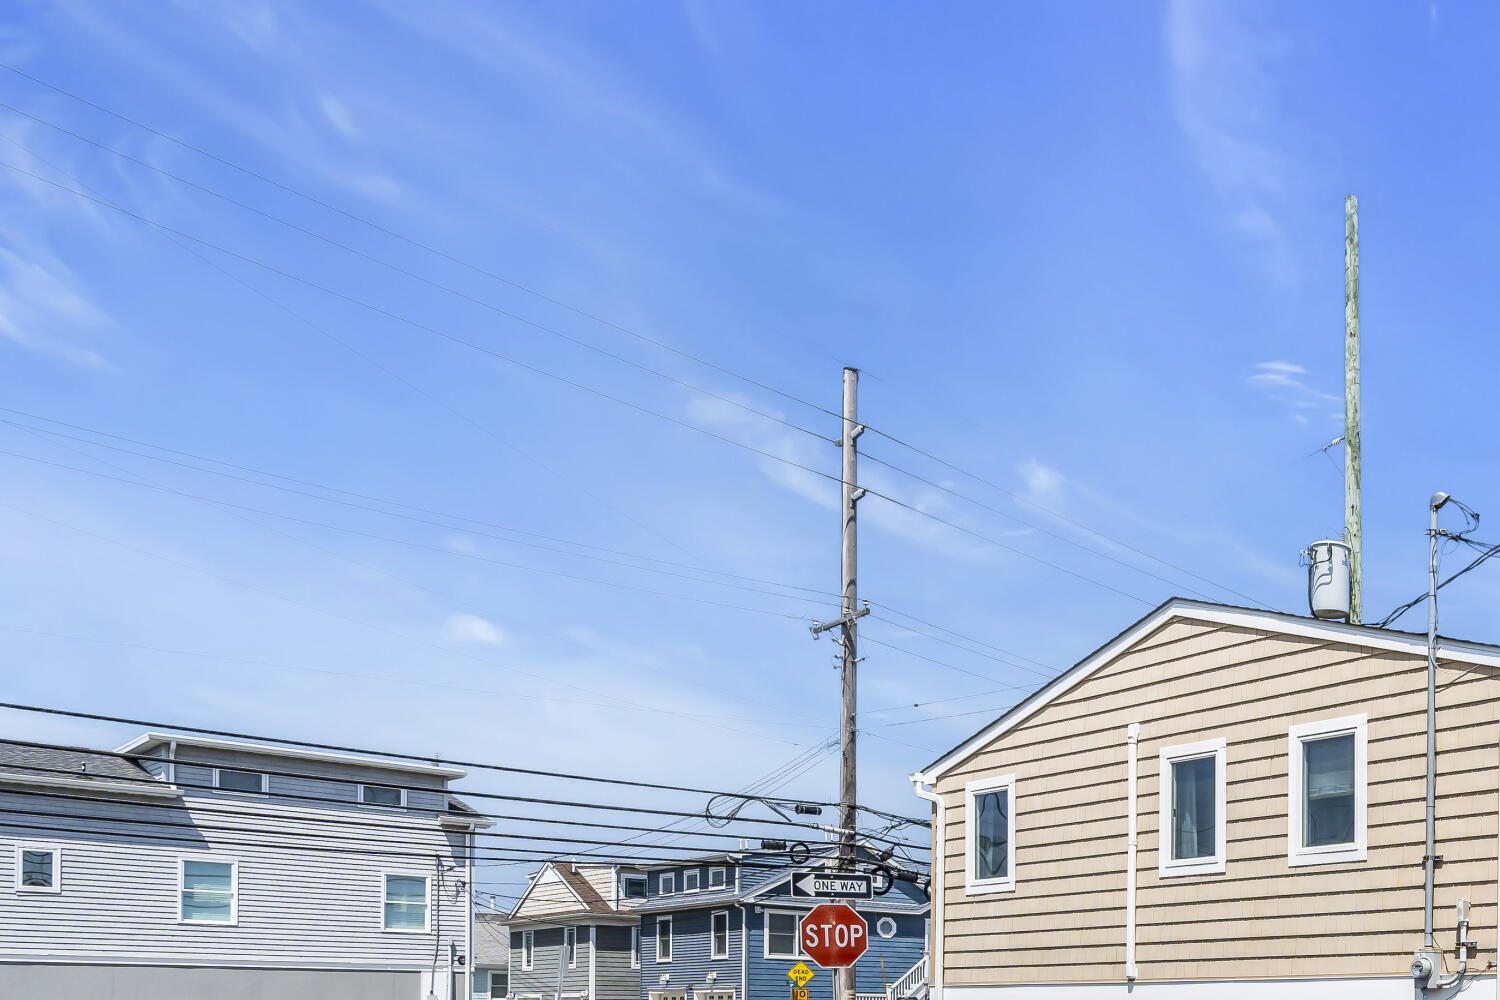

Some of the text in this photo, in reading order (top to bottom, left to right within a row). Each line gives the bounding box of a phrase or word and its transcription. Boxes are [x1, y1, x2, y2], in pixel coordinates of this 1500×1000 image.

[813, 880, 864, 892] ONE WAY
[805, 923, 863, 948] STOP
